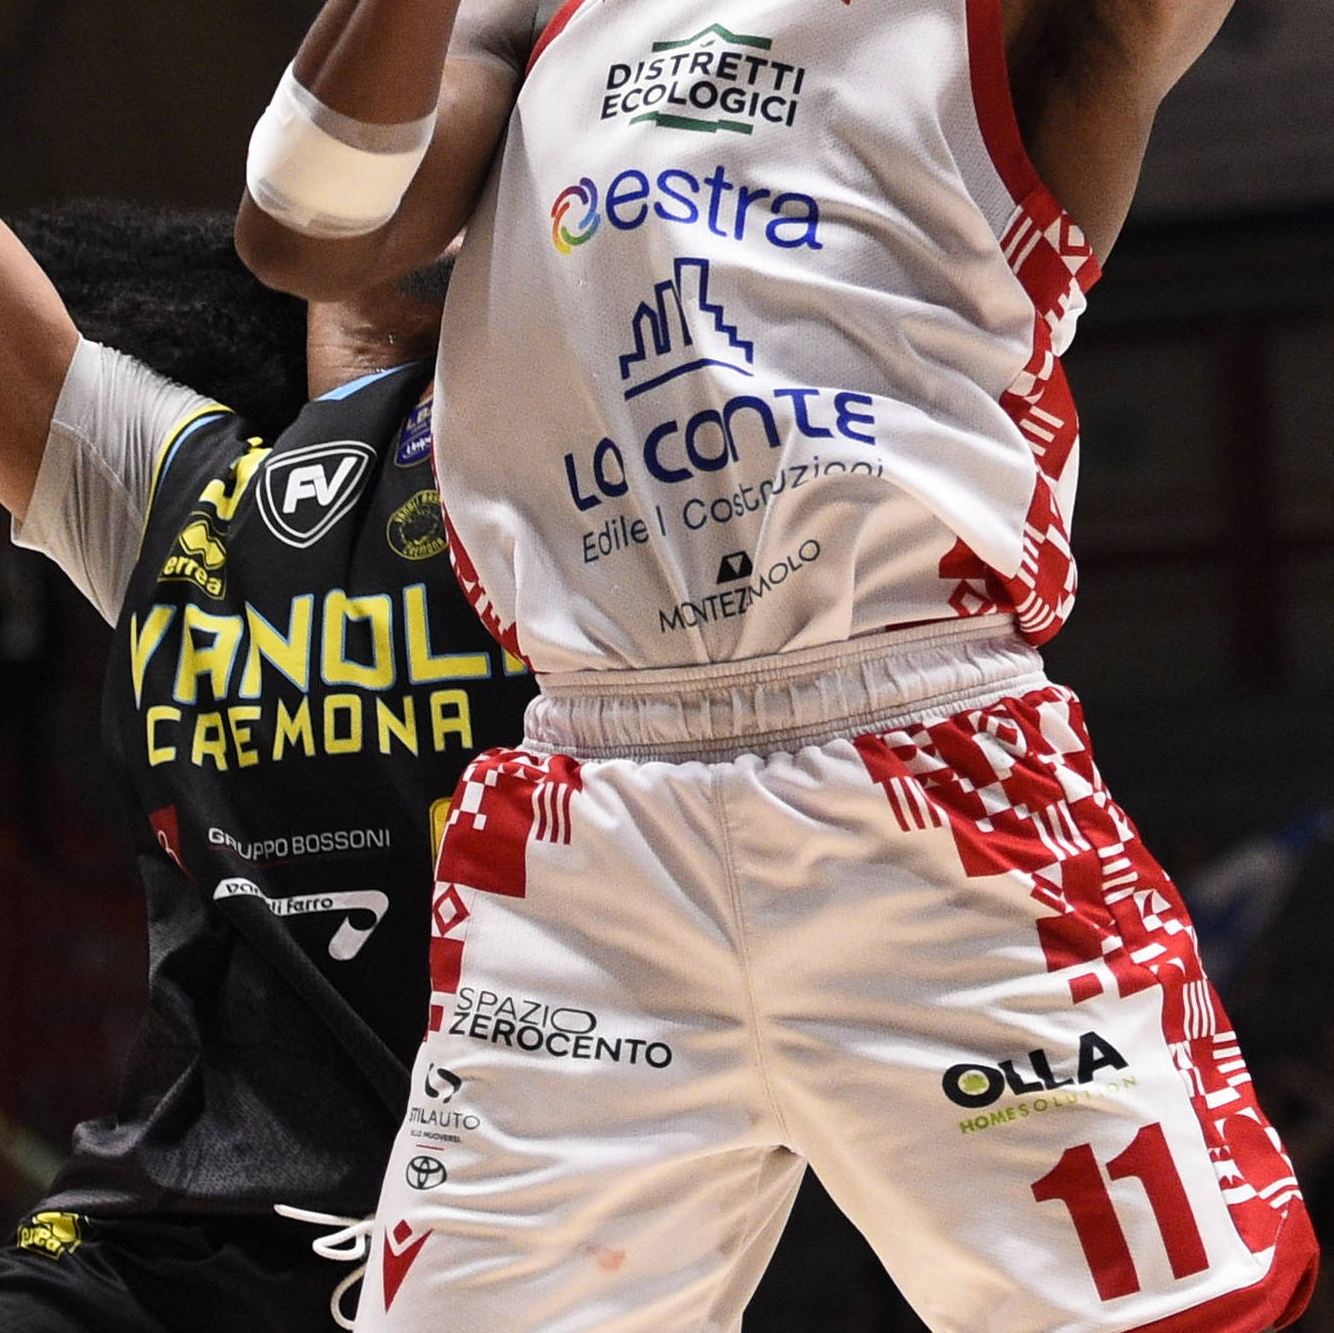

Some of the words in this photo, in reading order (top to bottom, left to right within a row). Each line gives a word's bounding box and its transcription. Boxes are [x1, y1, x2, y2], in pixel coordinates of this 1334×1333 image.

[606, 51, 805, 95] DISTRETTI
[600, 80, 797, 127] ECOLOGICI
[605, 165, 824, 250] estra
[583, 516, 648, 564] Edile
[146, 689, 473, 772] CREMONA
[208, 826, 289, 860] GRUPPO
[293, 828, 391, 855] BOSSONI
[456, 987, 597, 1034] SPAZIO
[448, 1012, 673, 1068] ZEROCENTO
[942, 1031, 1128, 1108] OLLA
[1030, 1121, 1210, 1302] 11
